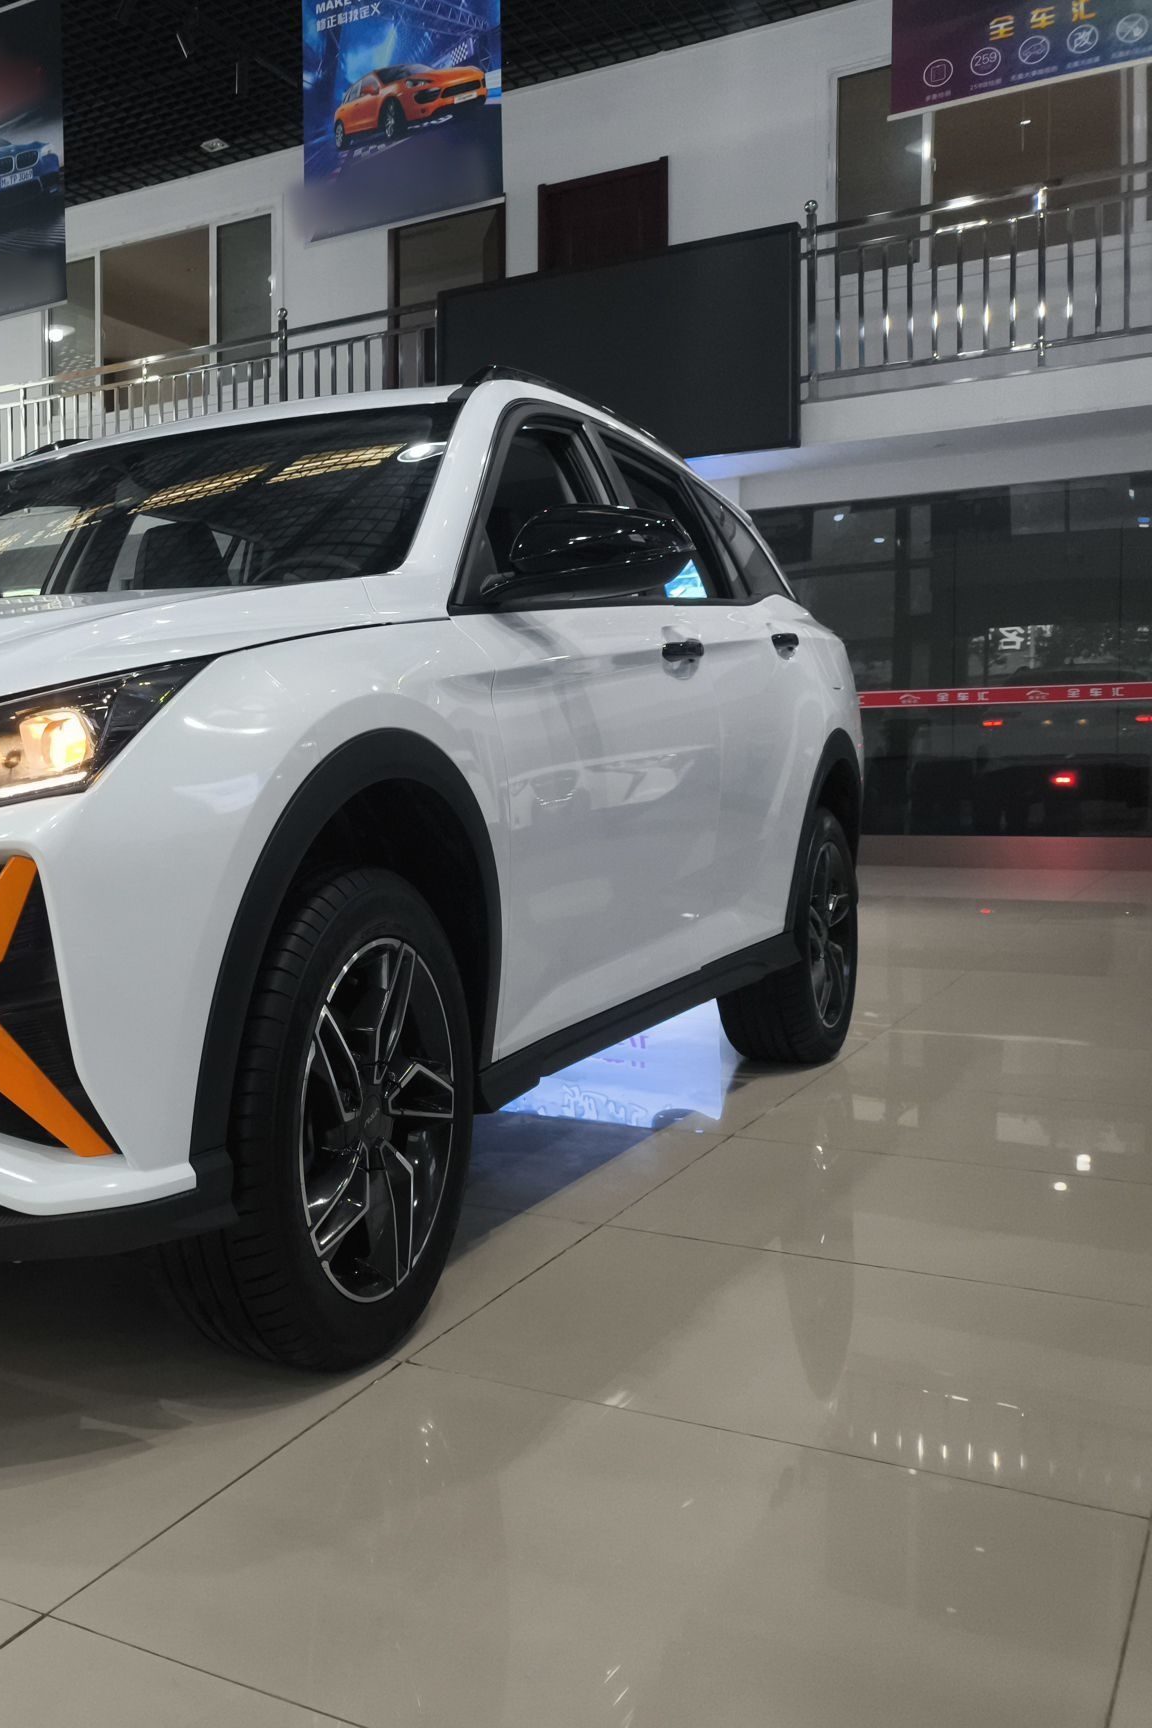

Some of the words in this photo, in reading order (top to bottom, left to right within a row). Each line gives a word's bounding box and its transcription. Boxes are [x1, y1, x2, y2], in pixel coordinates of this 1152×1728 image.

[974, 51, 998, 67] 259
[936, 691, 989, 702] 全车汇
[1067, 687, 1125, 698] 全车汇
